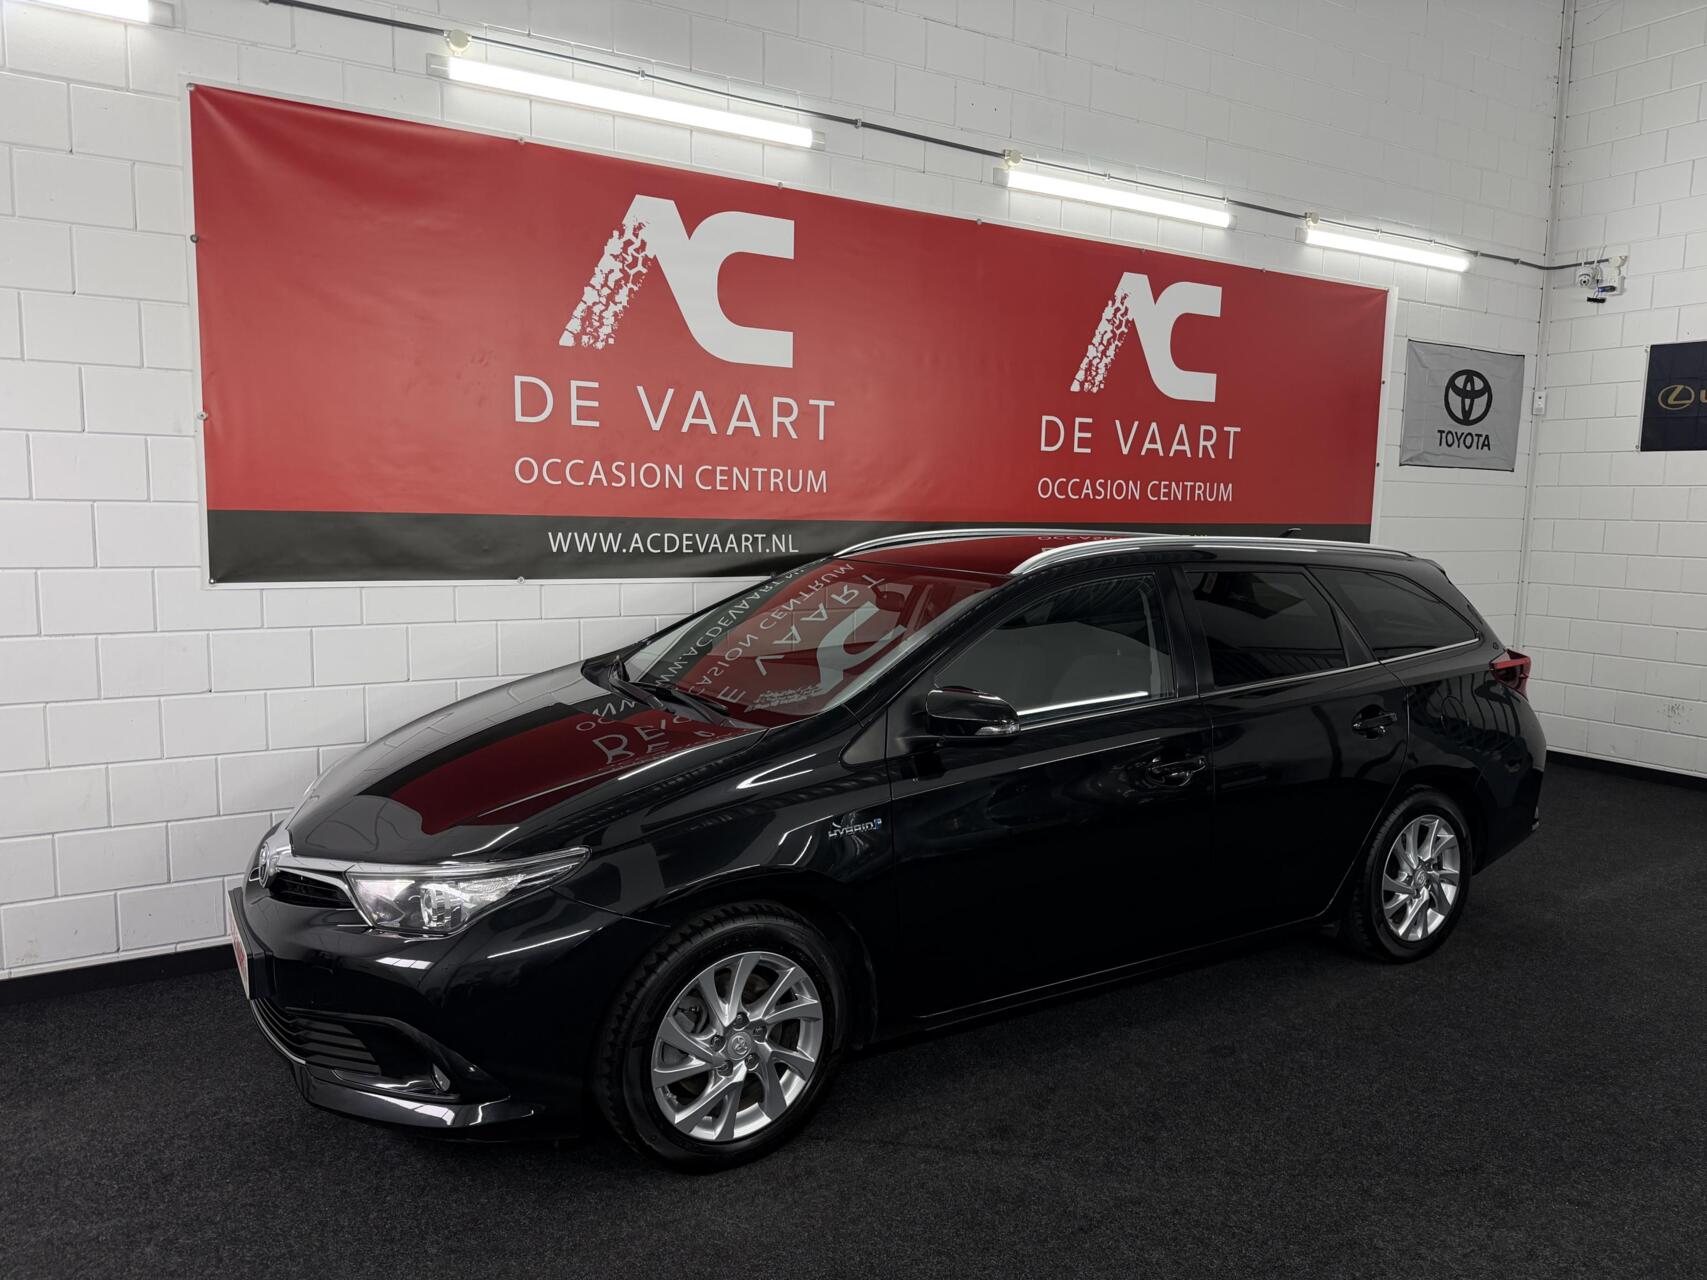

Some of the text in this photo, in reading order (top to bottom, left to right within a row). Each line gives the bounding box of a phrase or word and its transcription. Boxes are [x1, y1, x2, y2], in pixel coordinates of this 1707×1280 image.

[558, 194, 795, 369] AC
[1070, 271, 1223, 403] AC
[513, 374, 836, 441] DE VAART
[1040, 414, 1242, 460] DE VAART
[1437, 429, 1492, 451] TOYOTA
[514, 456, 828, 493] OCCASION CENTRUM
[1037, 477, 1233, 502] OCCASION CENTRUM
[547, 530, 800, 554] WWW.ACDEVAART.NL
